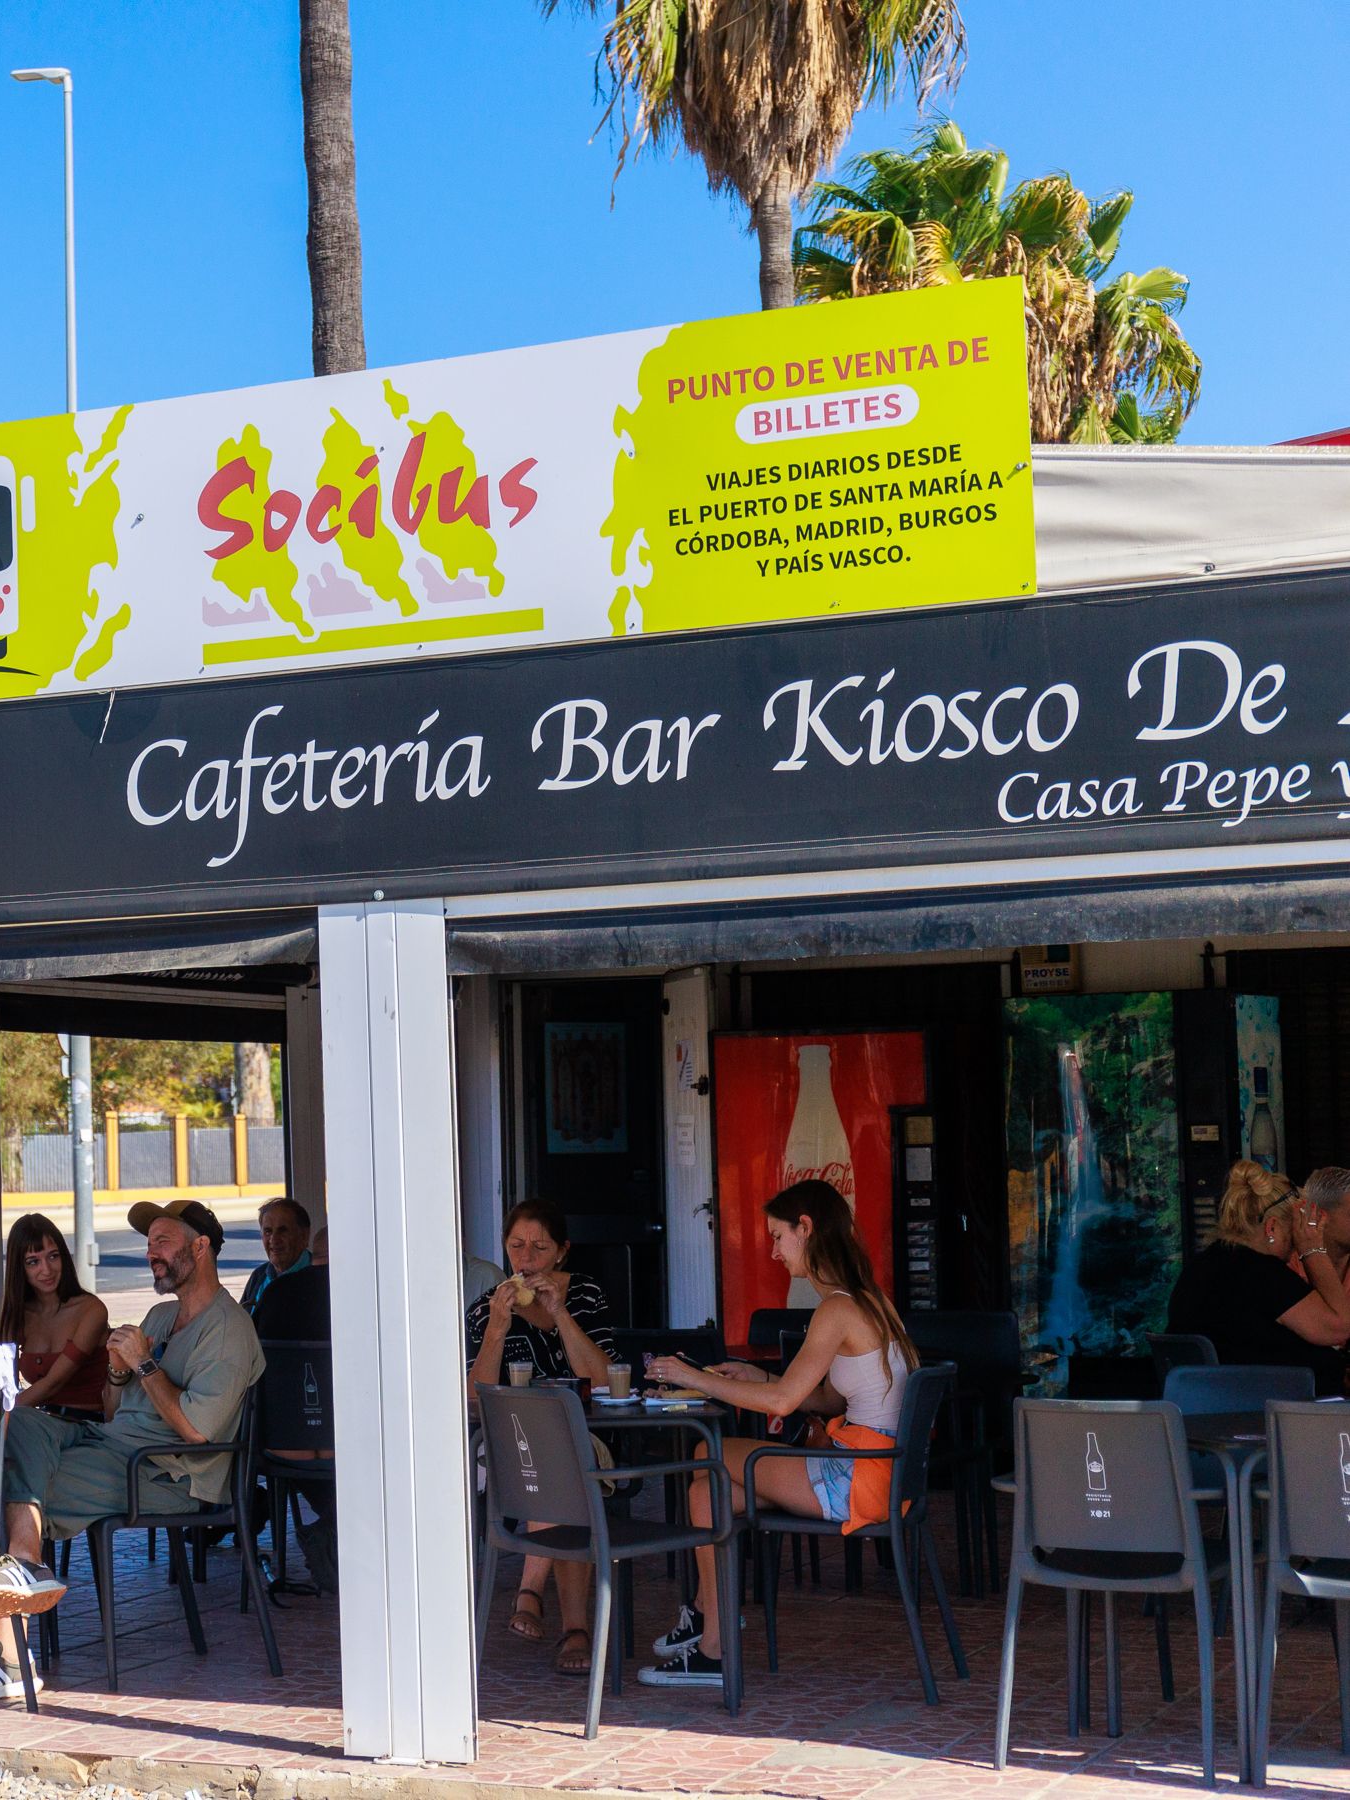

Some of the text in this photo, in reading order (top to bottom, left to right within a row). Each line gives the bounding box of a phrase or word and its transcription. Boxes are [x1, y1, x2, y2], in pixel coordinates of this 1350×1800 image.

[667, 336, 990, 404] PUNTO DE VENTA DE
[753, 393, 903, 436] BILLETES
[706, 443, 962, 491] VIAJES DIARIOS DESDE
[197, 431, 539, 560] Socibus
[668, 469, 1003, 527] EL PUERTO DE SANTA MARÍA A
[675, 503, 998, 556] CÓRDOBA, MADRID, BURGOS
[756, 544, 912, 578] Y PAÍS VASCO.
[126, 640, 1289, 868] Cafetería Bar Kíosco De
[997, 772, 1144, 824] Casa
[1159, 760, 1312, 828] Pepe
[1024, 967, 1070, 978] PROYSE
